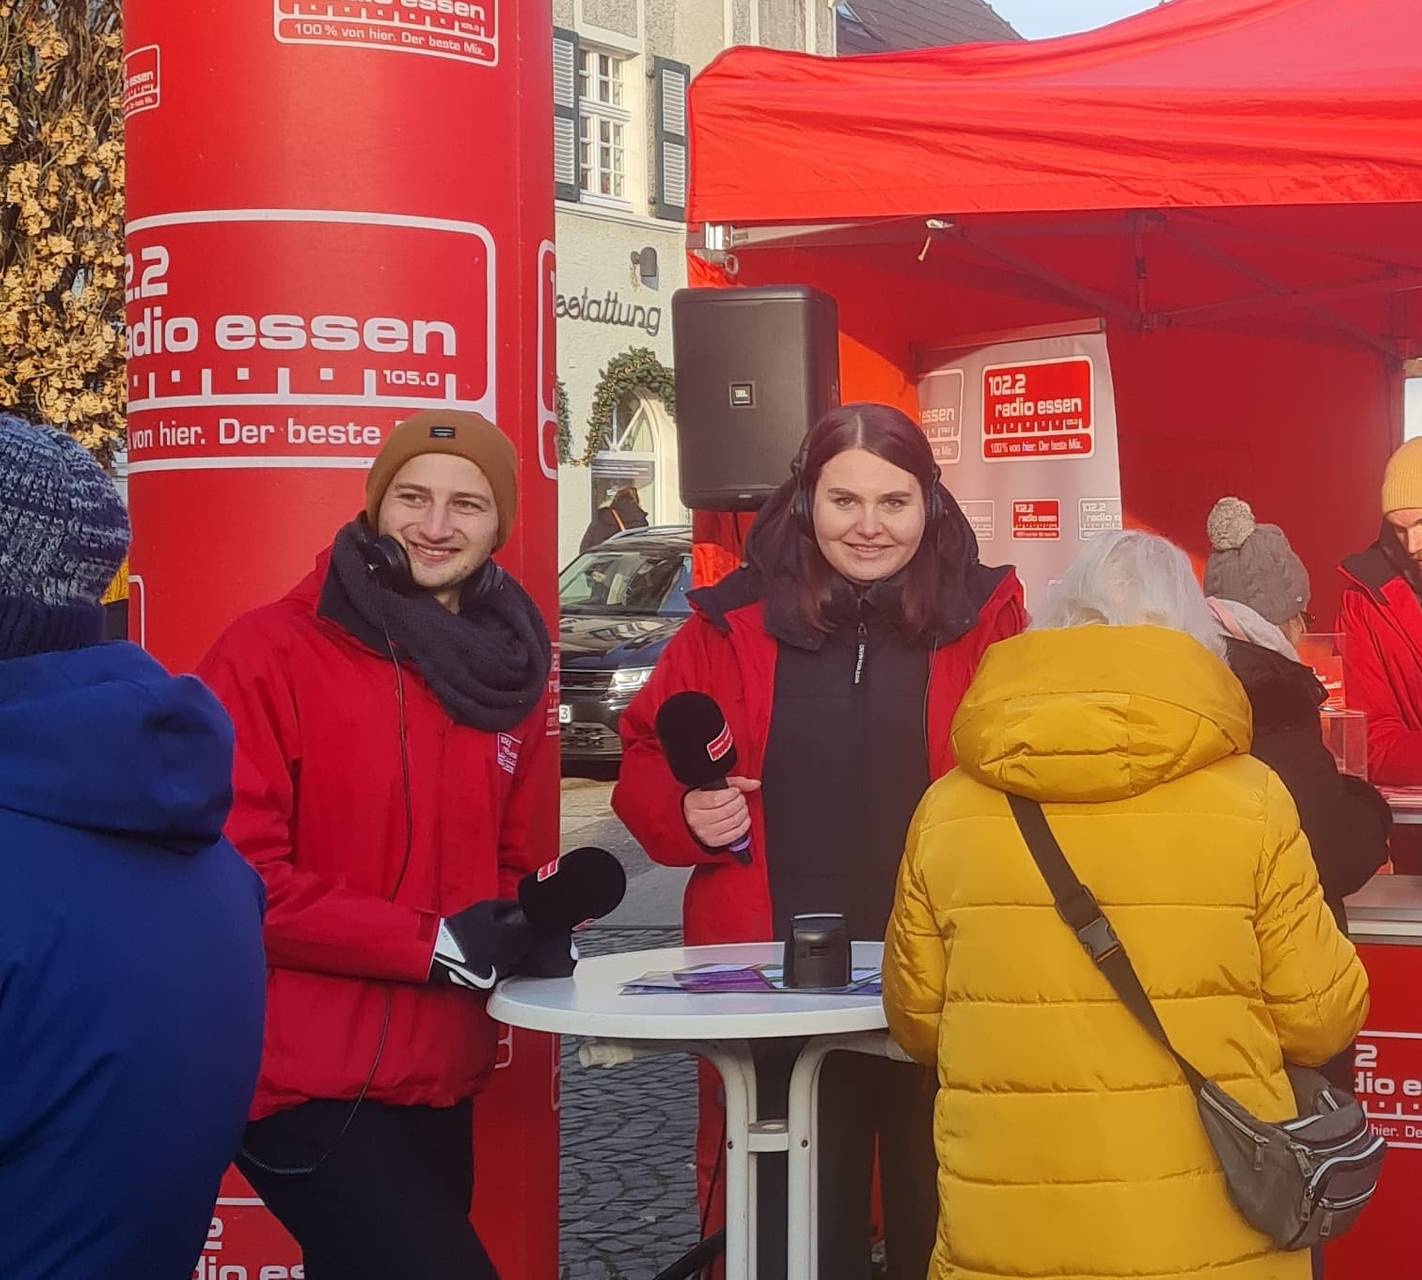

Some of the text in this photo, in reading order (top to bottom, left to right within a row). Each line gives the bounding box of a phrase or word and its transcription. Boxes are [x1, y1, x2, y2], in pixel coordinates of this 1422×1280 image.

[341, 28, 364, 39] von
[369, 29, 397, 42] hier.
[402, 31, 425, 45] Der
[429, 36, 460, 51] beste
[215, 314, 456, 356] essen
[383, 369, 440, 386] 105.0
[989, 374, 1026, 397] 102.2
[995, 397, 1082, 418] radio essen
[132, 417, 381, 450] von hier. Der beste
[560, 707, 568, 720] 3
[1371, 1124, 1400, 1138] hier.
